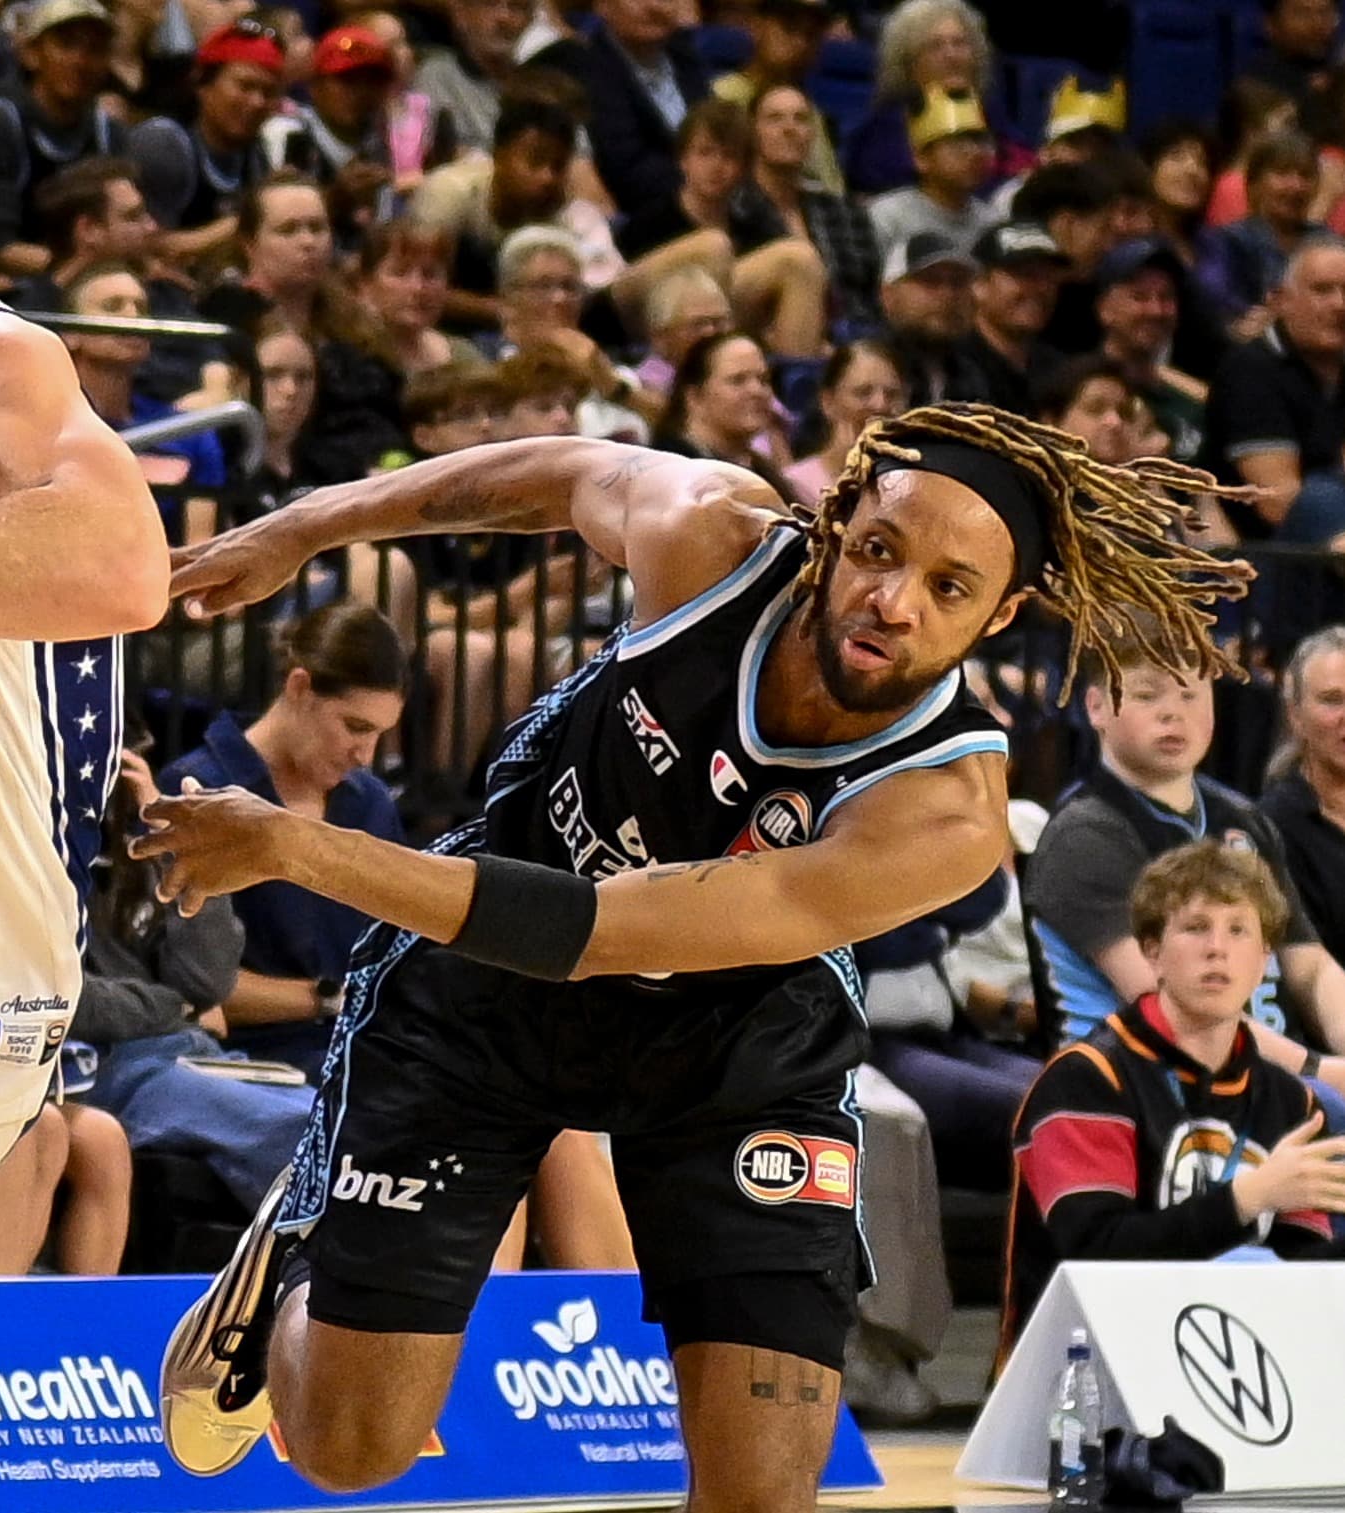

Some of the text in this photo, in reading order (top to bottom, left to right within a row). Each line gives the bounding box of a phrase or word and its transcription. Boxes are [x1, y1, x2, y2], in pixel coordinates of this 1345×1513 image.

[759, 802, 799, 846] NBL
[0, 993, 70, 1015] Australia
[751, 1150, 794, 1182] NBL
[332, 1154, 428, 1212] bnz
[495, 1346, 680, 1420] goodhe
[545, 1412, 649, 1431] NATURALLY
[19, 1427, 65, 1447] NEW
[75, 1425, 164, 1446] ZEALAND
[579, 1441, 639, 1463] Natural
[51, 1457, 162, 1484] Supplements
